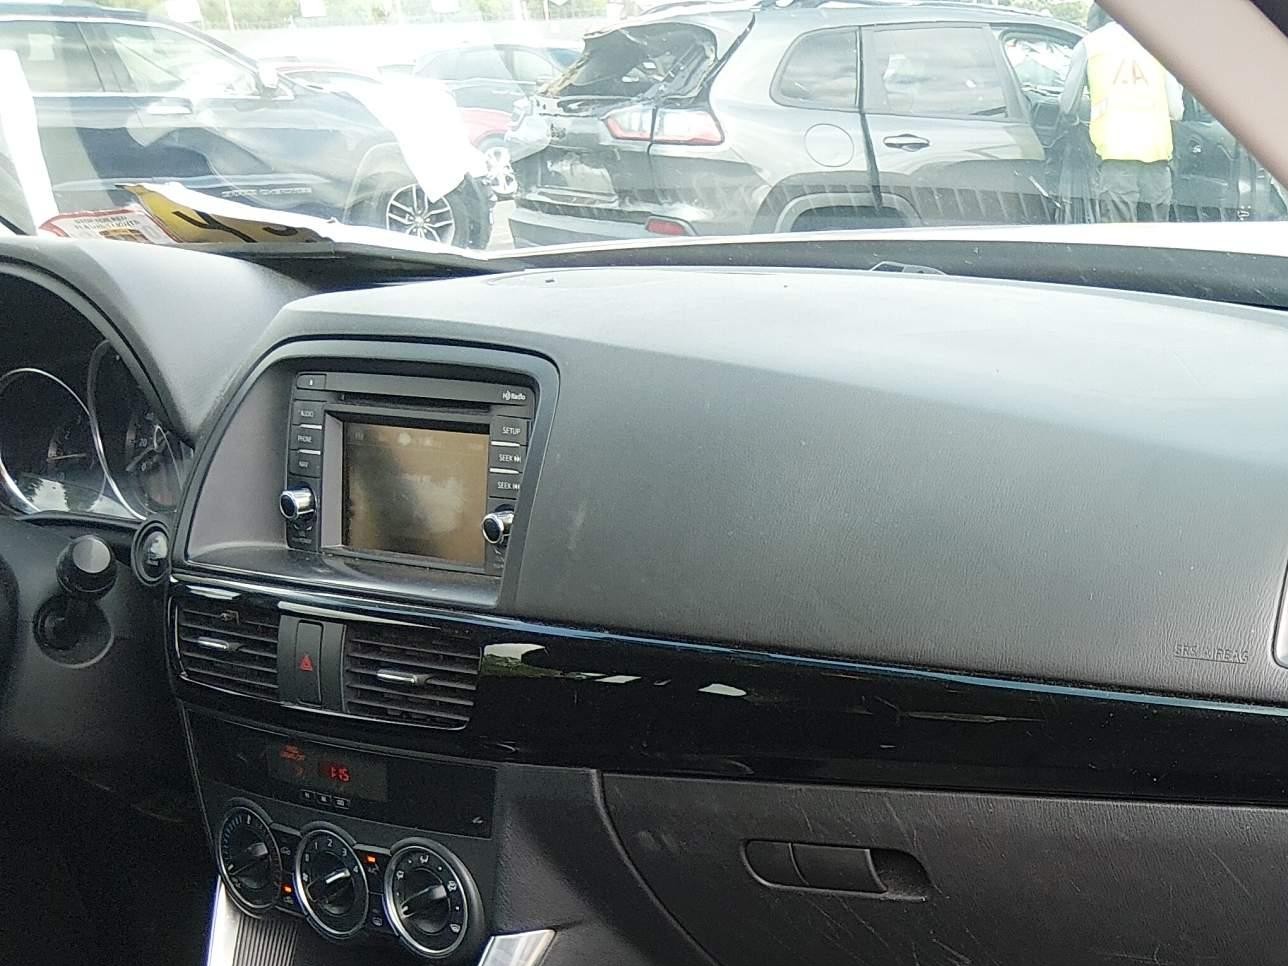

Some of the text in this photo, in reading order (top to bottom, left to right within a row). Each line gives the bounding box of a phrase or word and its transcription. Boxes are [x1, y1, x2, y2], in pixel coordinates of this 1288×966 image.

[502, 426, 521, 435] SETUP
[499, 453, 513, 462] SEEK
[497, 480, 511, 490] SEEK
[327, 838, 333, 848] 2
[341, 847, 348, 857] 3
[352, 864, 359, 873] 4
